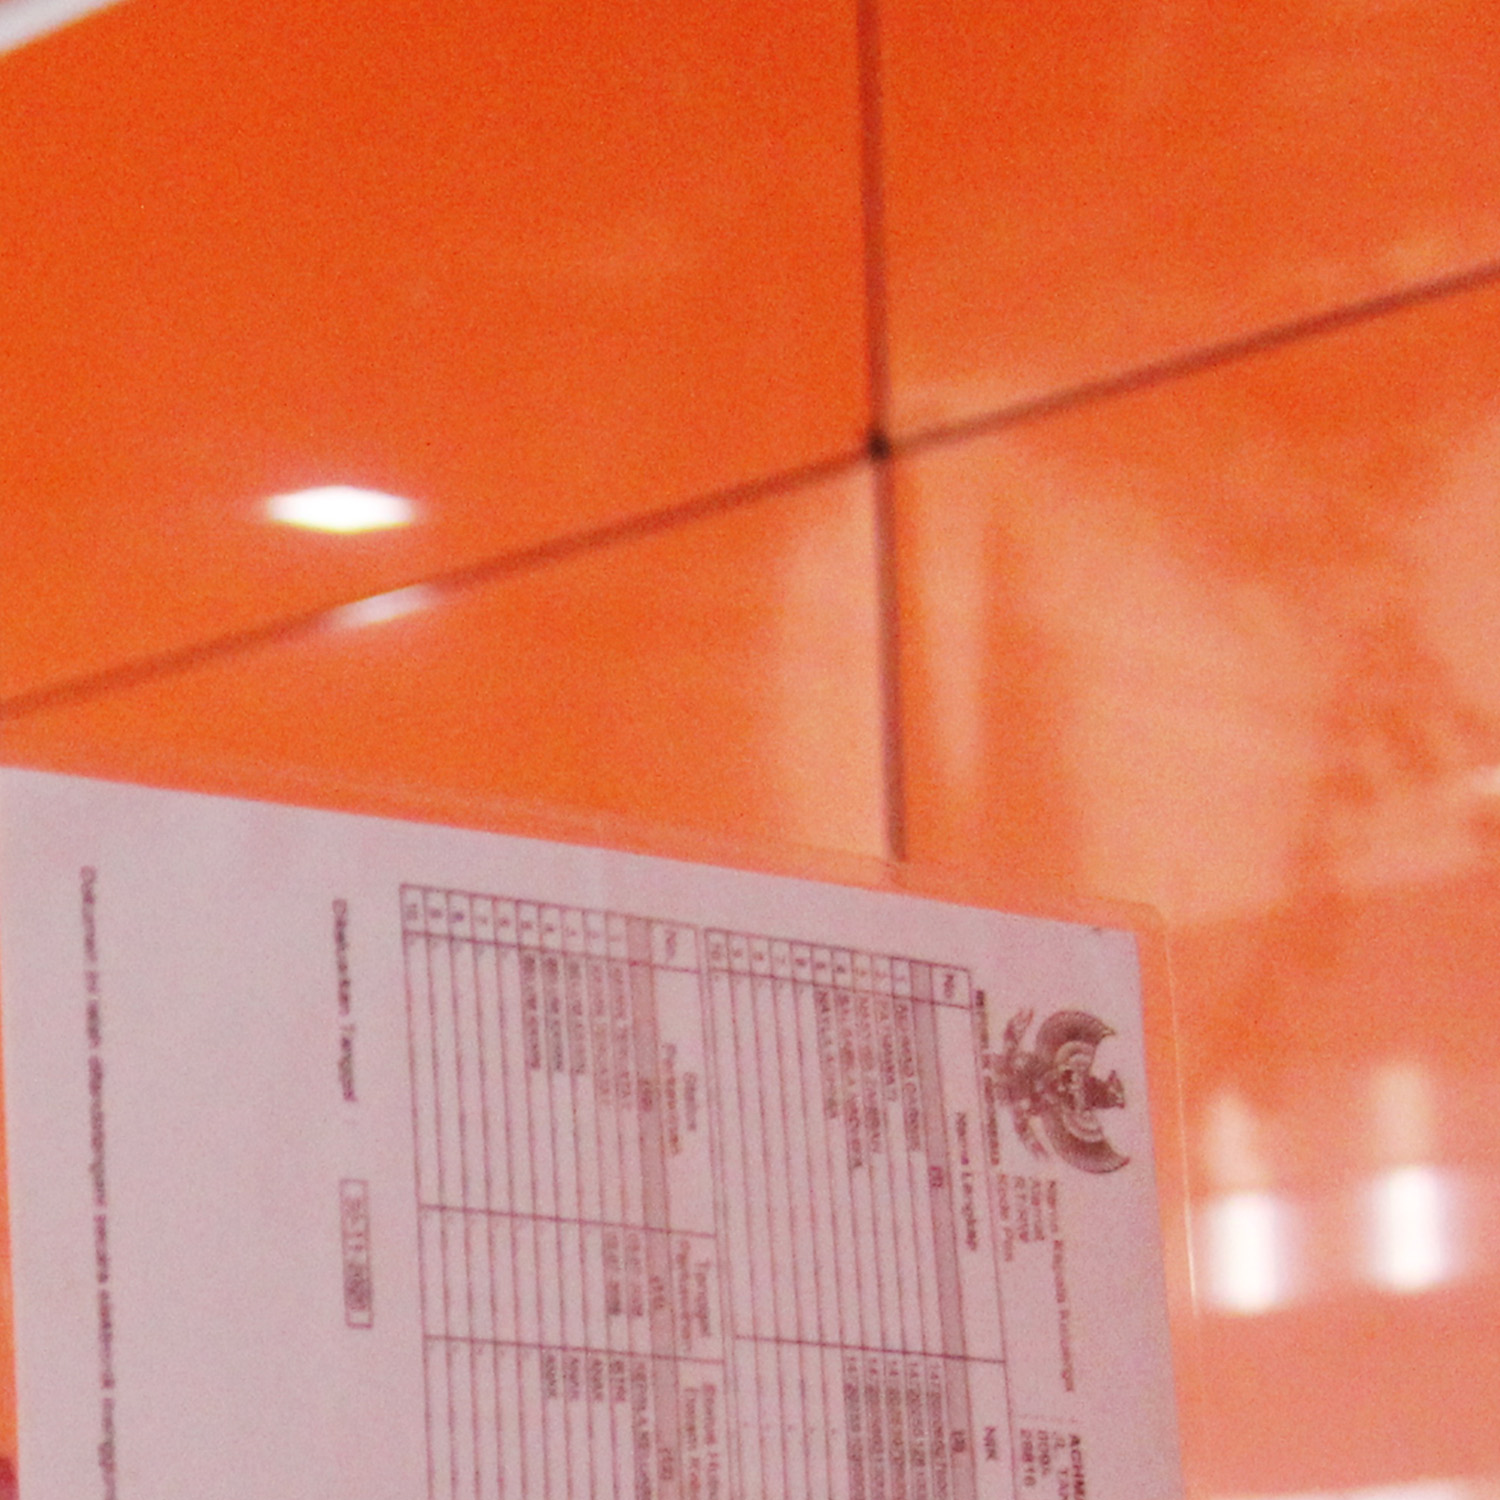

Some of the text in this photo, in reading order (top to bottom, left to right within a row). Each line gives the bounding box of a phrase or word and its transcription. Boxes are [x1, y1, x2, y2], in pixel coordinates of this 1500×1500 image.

[78, 867, 97, 963] Dokumen
[331, 899, 358, 1103] Dikeluarkan Tanggal
